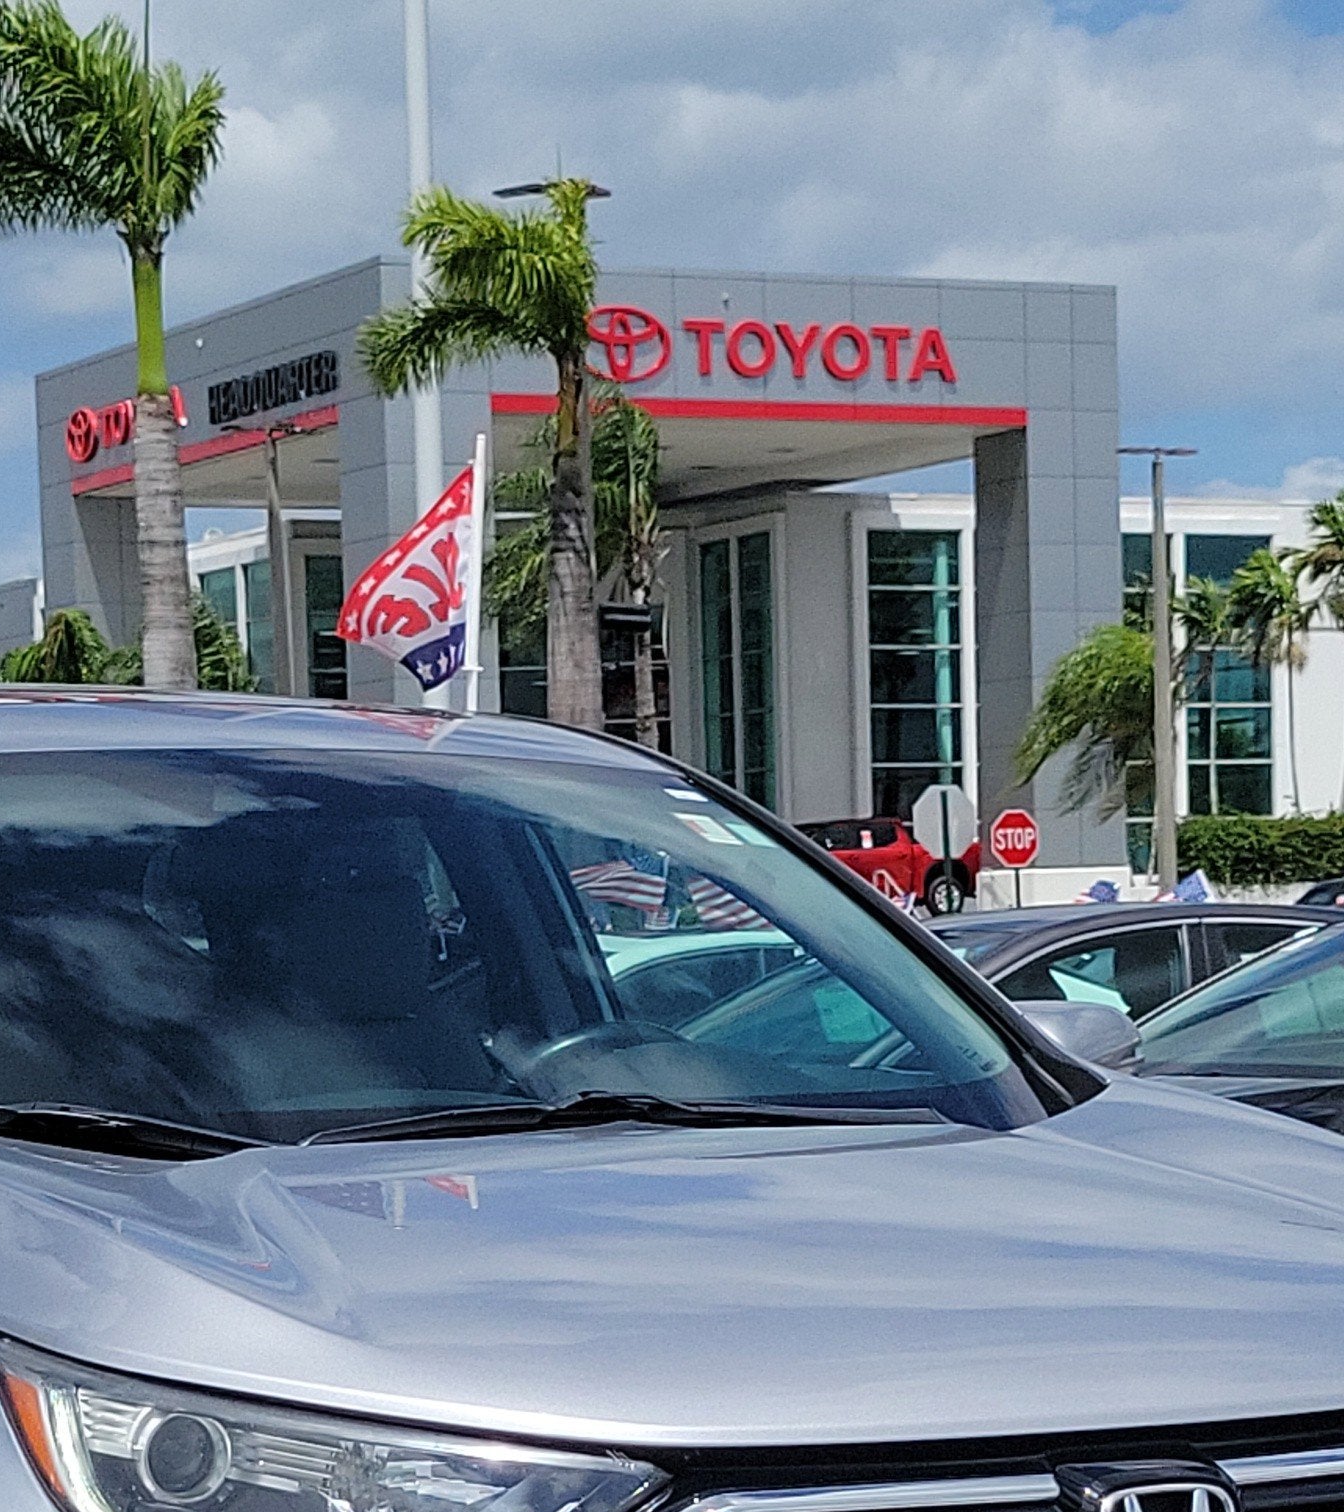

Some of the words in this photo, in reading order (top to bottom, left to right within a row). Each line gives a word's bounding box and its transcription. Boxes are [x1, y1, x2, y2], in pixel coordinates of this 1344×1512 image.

[682, 318, 957, 383] TOYOTA
[208, 350, 338, 425] HEADQUARTER
[996, 827, 1035, 851] STOP
